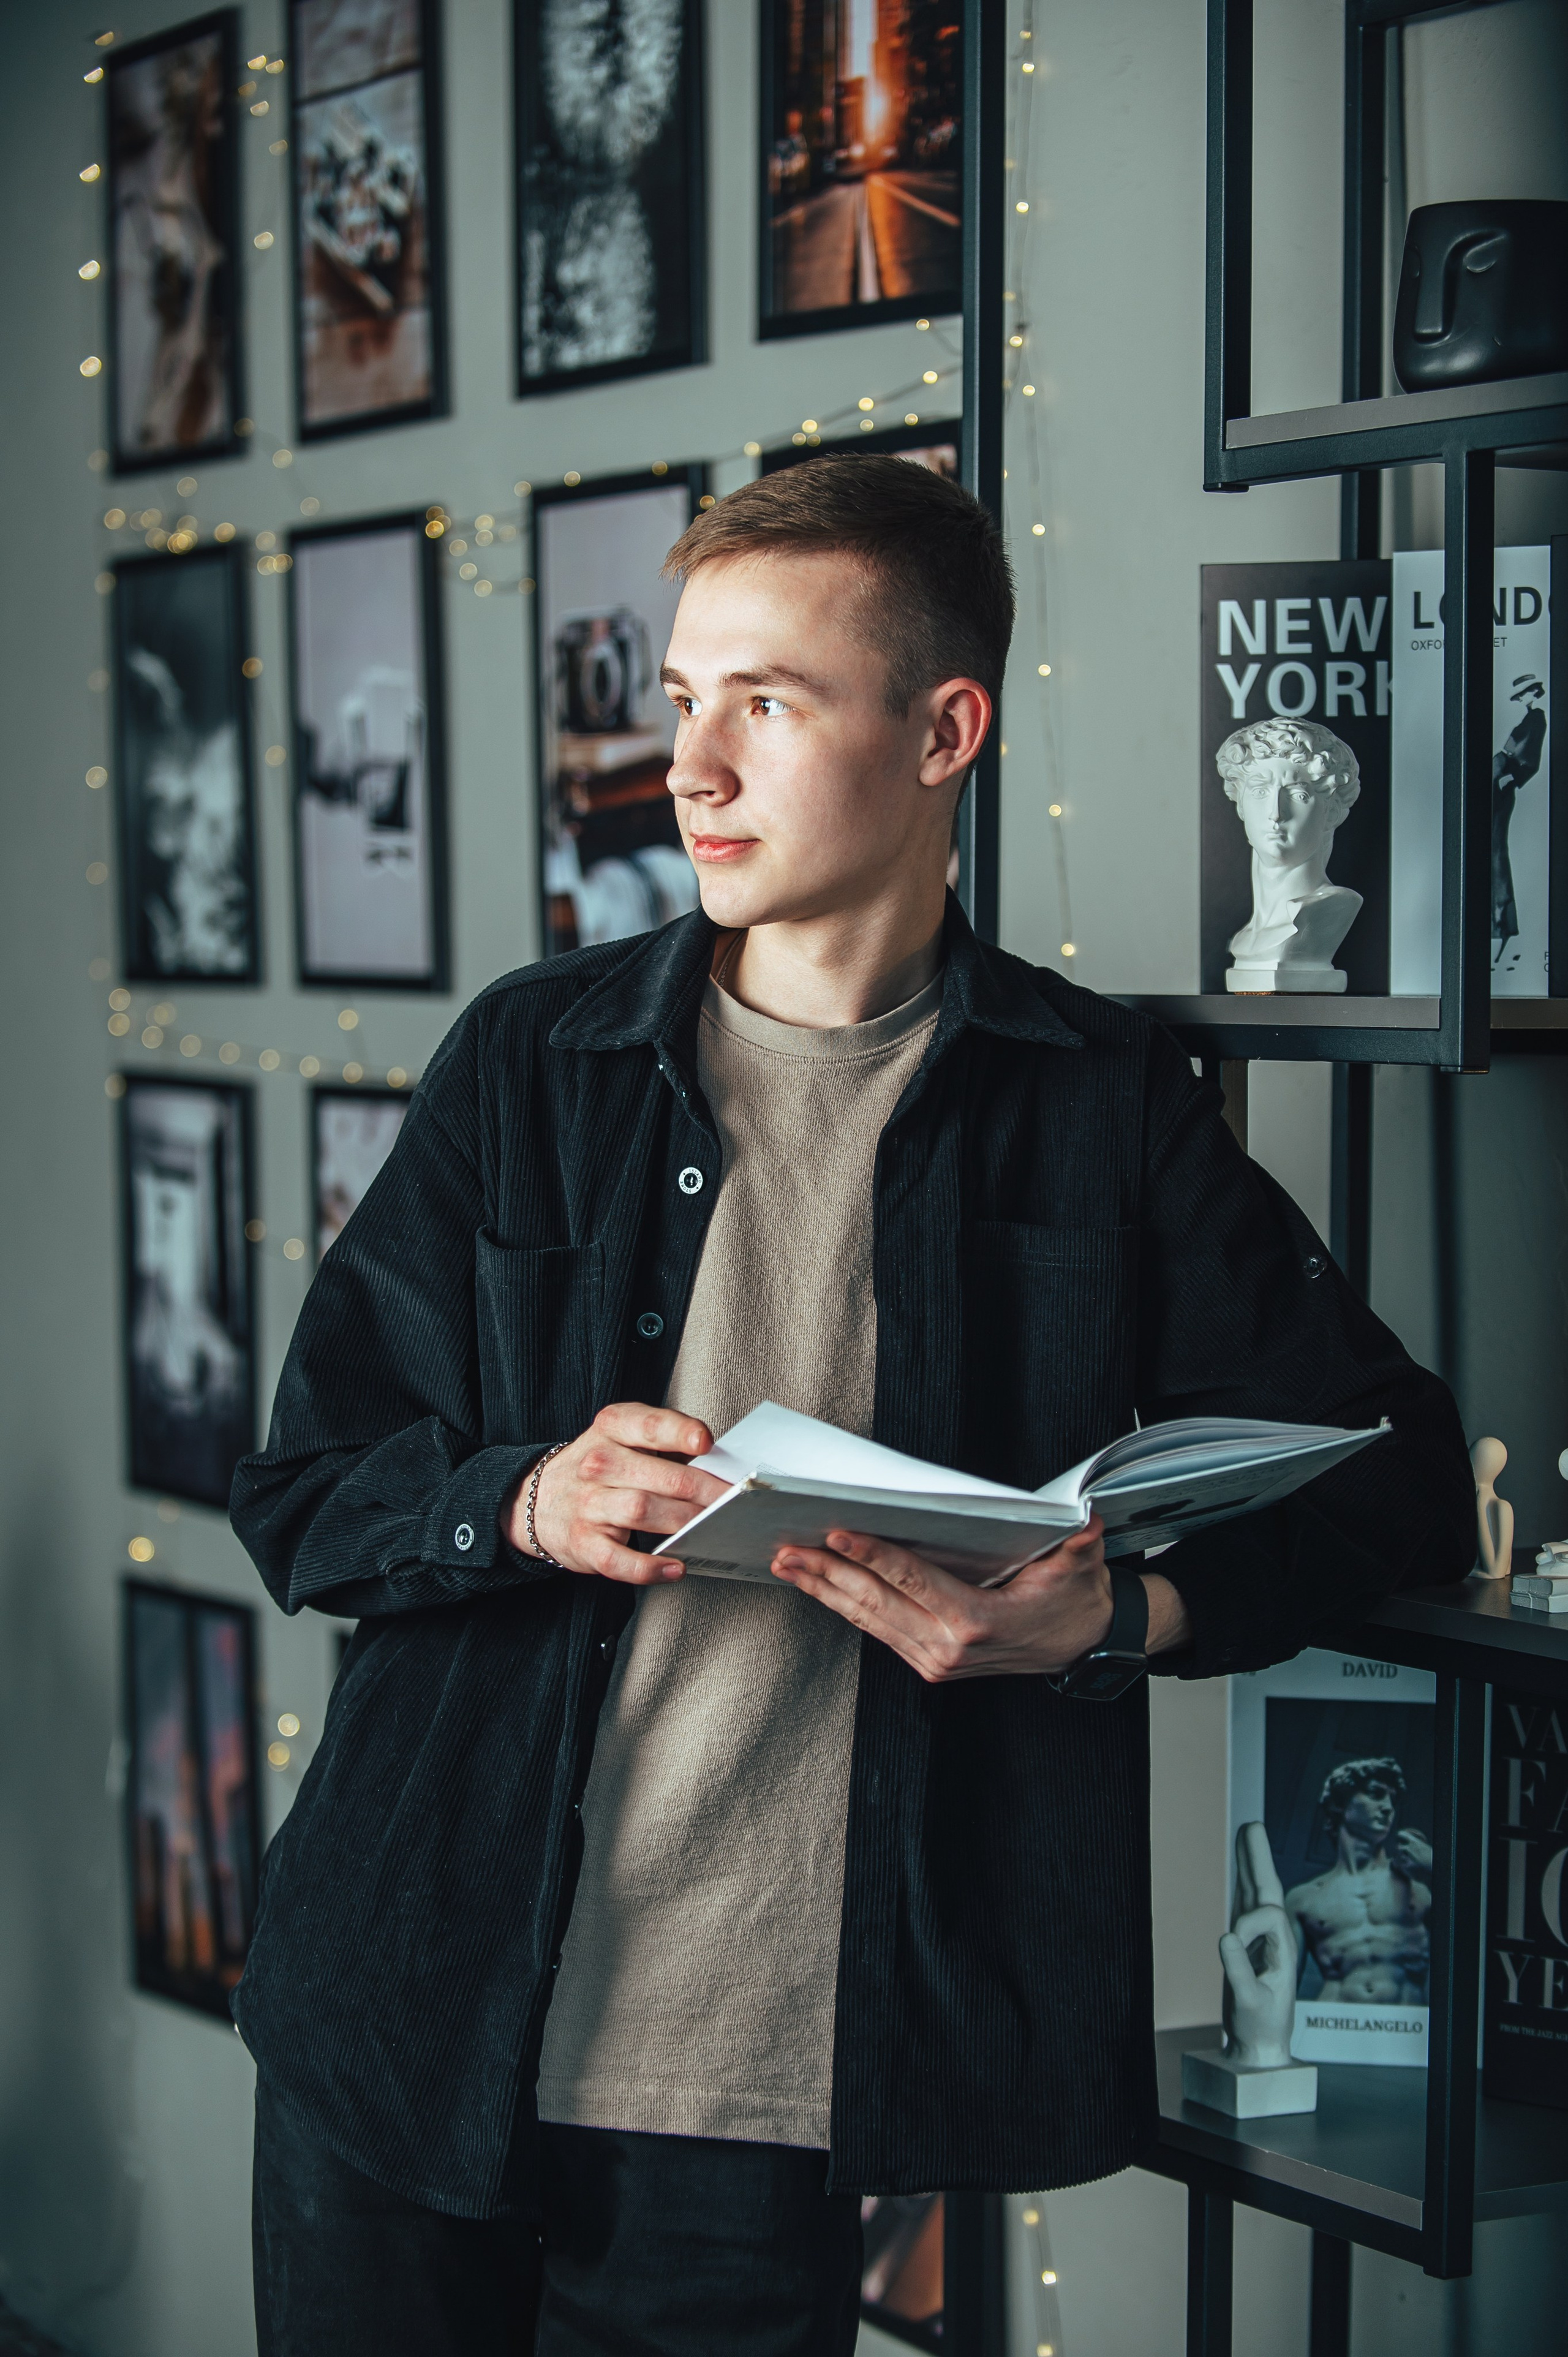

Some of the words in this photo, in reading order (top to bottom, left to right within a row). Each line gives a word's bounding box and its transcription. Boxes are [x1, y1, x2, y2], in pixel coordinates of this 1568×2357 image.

[1218, 597, 1388, 655] NEW
[1411, 639, 1444, 651] OXFO
[1342, 1661, 1398, 1679] DAVID
[1306, 2016, 1423, 2034] MICHELANGELO
